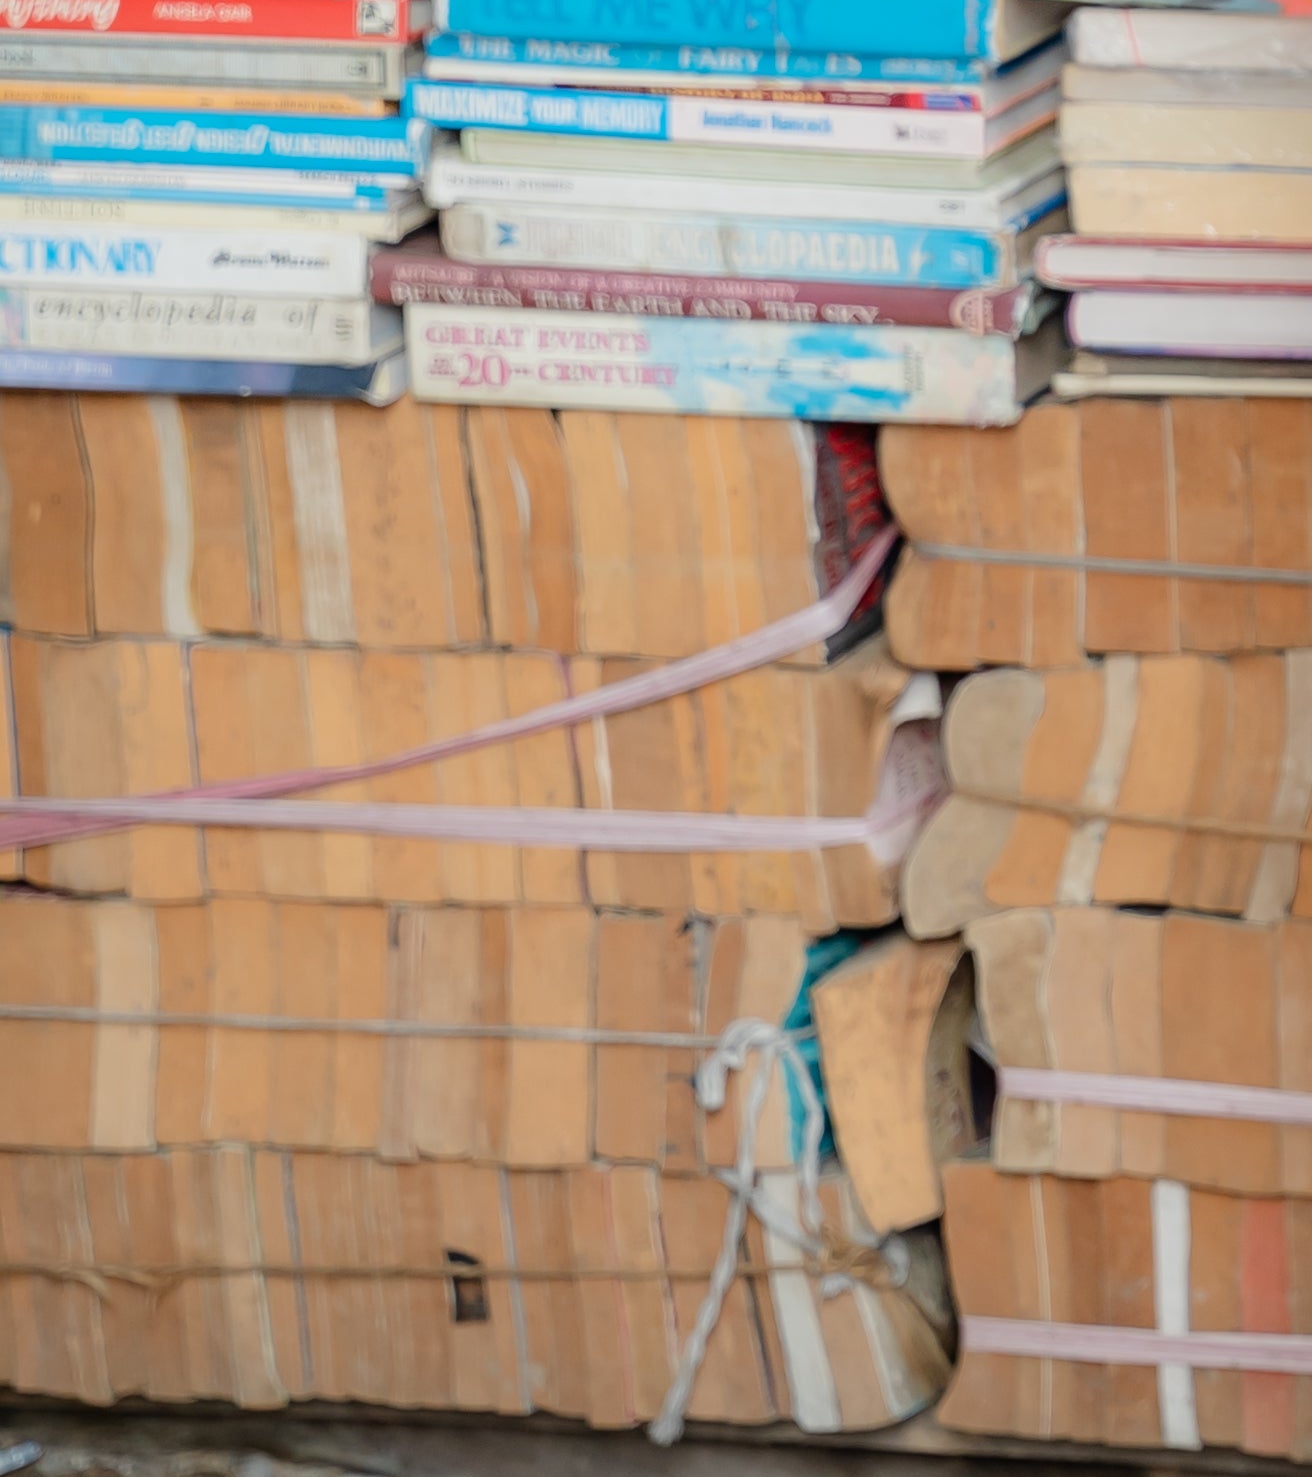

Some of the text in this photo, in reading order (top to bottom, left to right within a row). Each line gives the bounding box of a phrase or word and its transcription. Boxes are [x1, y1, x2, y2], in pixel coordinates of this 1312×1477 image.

[678, 47, 764, 74] FAIRY
[414, 83, 529, 128] MAXIMIZE
[582, 94, 669, 135] MEMORY
[194, 125, 270, 154] DESIGN
[270, 129, 412, 160] NVIRONMENTAL
[0, 237, 161, 276] CTIONARY
[32, 290, 320, 335] encyclopedia of
[390, 284, 524, 307] BETWEEN
[529, 289, 587, 311] THE
[590, 293, 686, 316] EARTH
[690, 298, 753, 321] AND
[759, 299, 817, 323] THE
[424, 325, 652, 354] GREAT EVENTS
[537, 361, 679, 387] CENTURY
